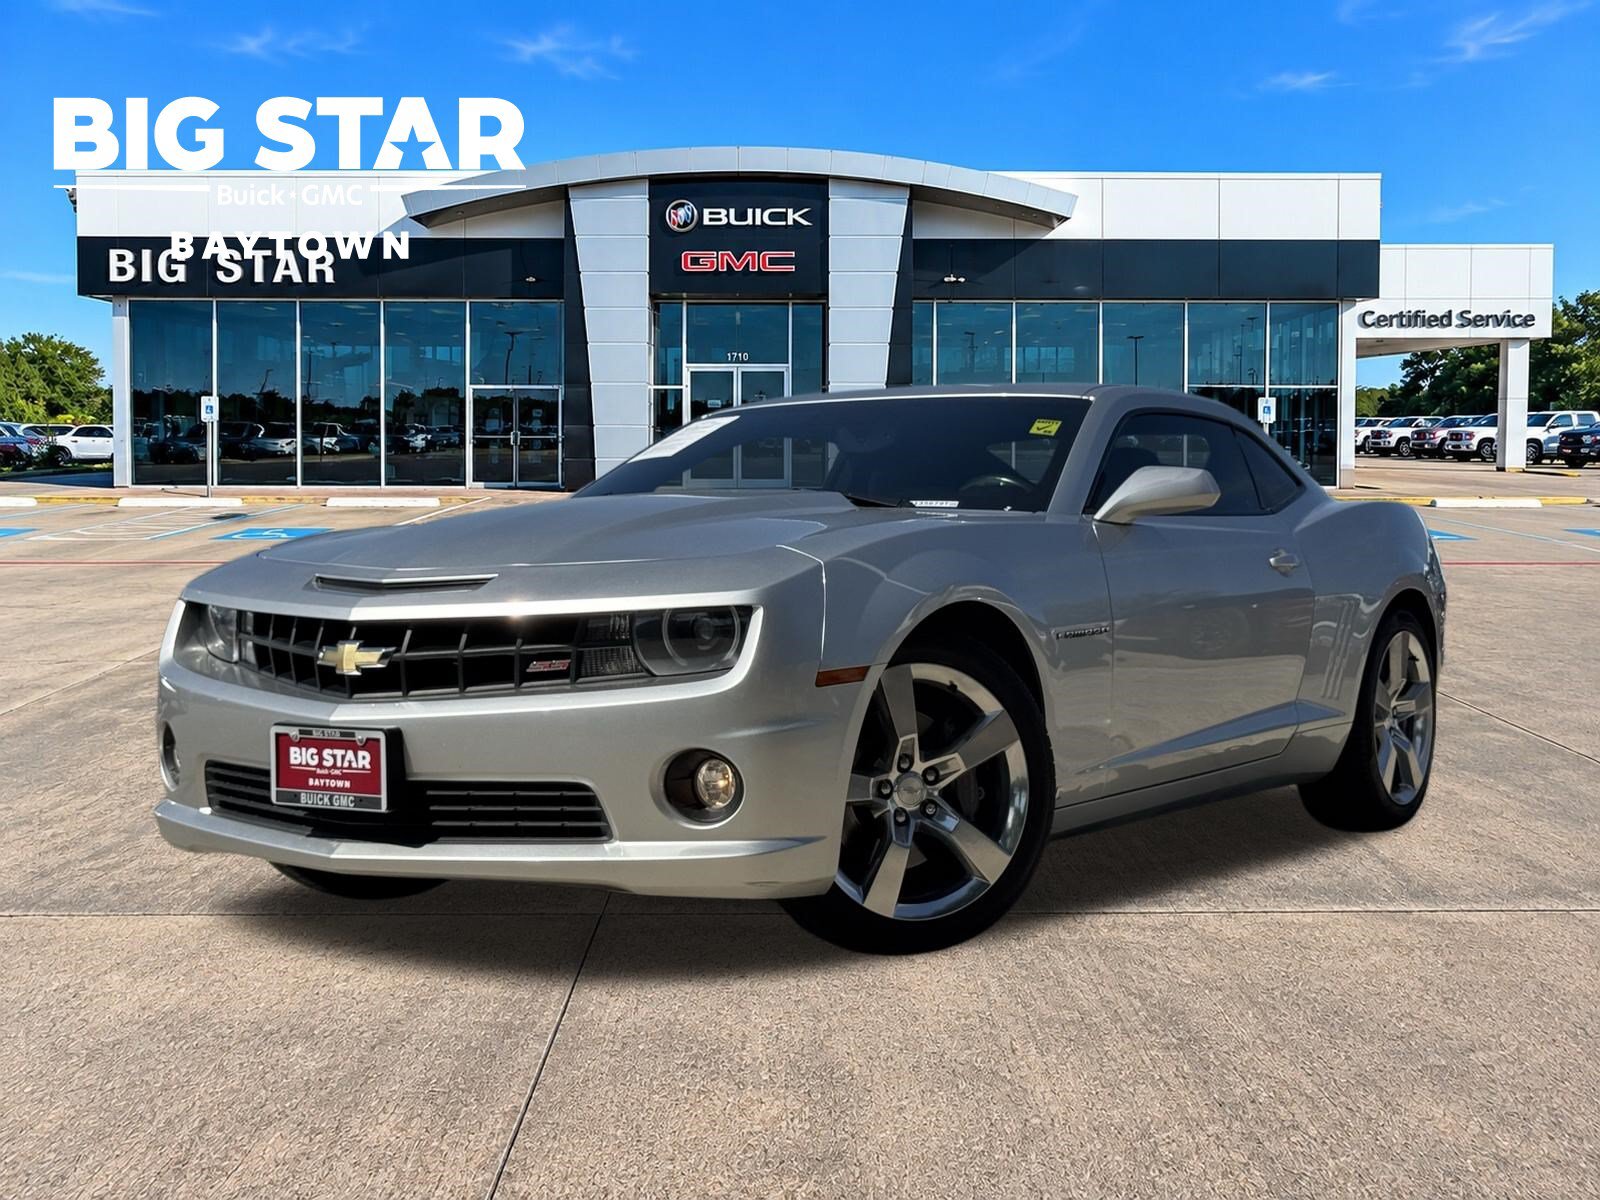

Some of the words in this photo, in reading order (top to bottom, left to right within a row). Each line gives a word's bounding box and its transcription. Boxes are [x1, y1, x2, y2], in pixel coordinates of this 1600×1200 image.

[702, 207, 813, 226] BUICK
[108, 247, 187, 284] BIG
[215, 249, 336, 284] STAR
[680, 250, 796, 272] GMC
[1360, 309, 1453, 328] Certified
[1456, 309, 1536, 328] Service
[727, 352, 749, 361] 1710
[289, 746, 319, 766] BIG
[322, 748, 371, 769] STAR
[309, 778, 351, 788] BAYTOWN
[300, 793, 330, 805] BUICK
[333, 795, 355, 807] GMC
